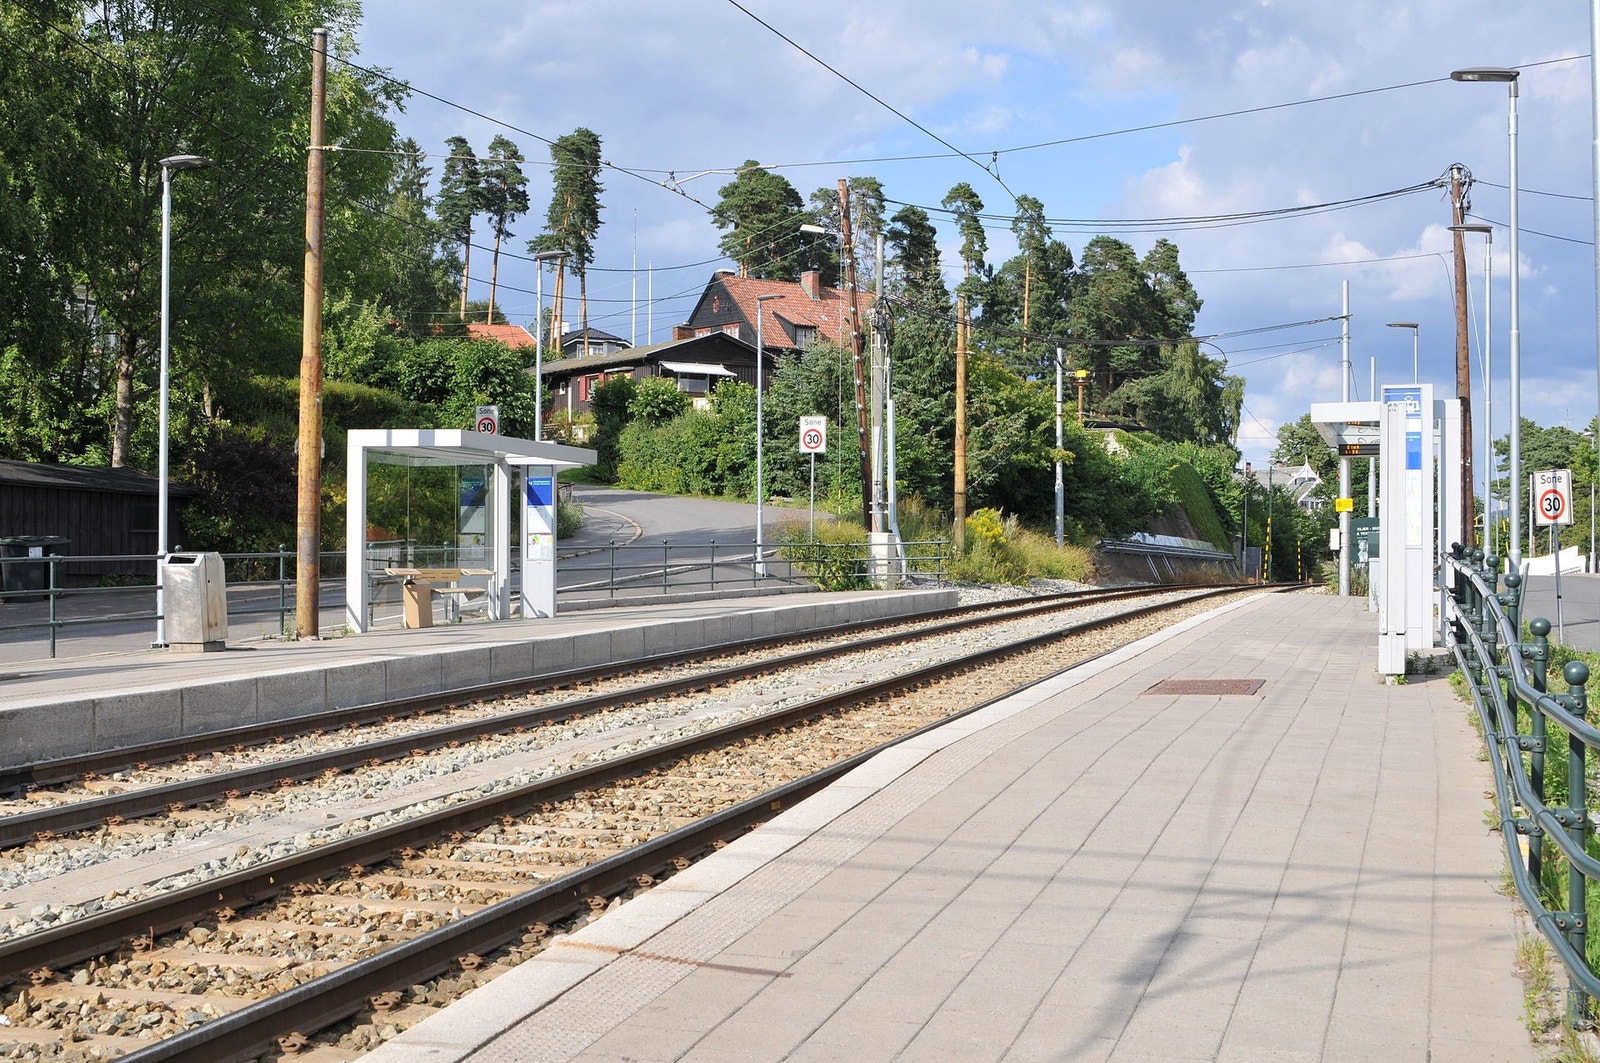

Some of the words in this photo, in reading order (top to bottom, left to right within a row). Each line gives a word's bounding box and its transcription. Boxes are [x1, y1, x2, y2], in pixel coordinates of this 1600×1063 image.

[481, 422, 493, 432] 30
[807, 434, 819, 444] 30
[1540, 475, 1562, 484] Sone
[1544, 498, 1560, 512] 30
